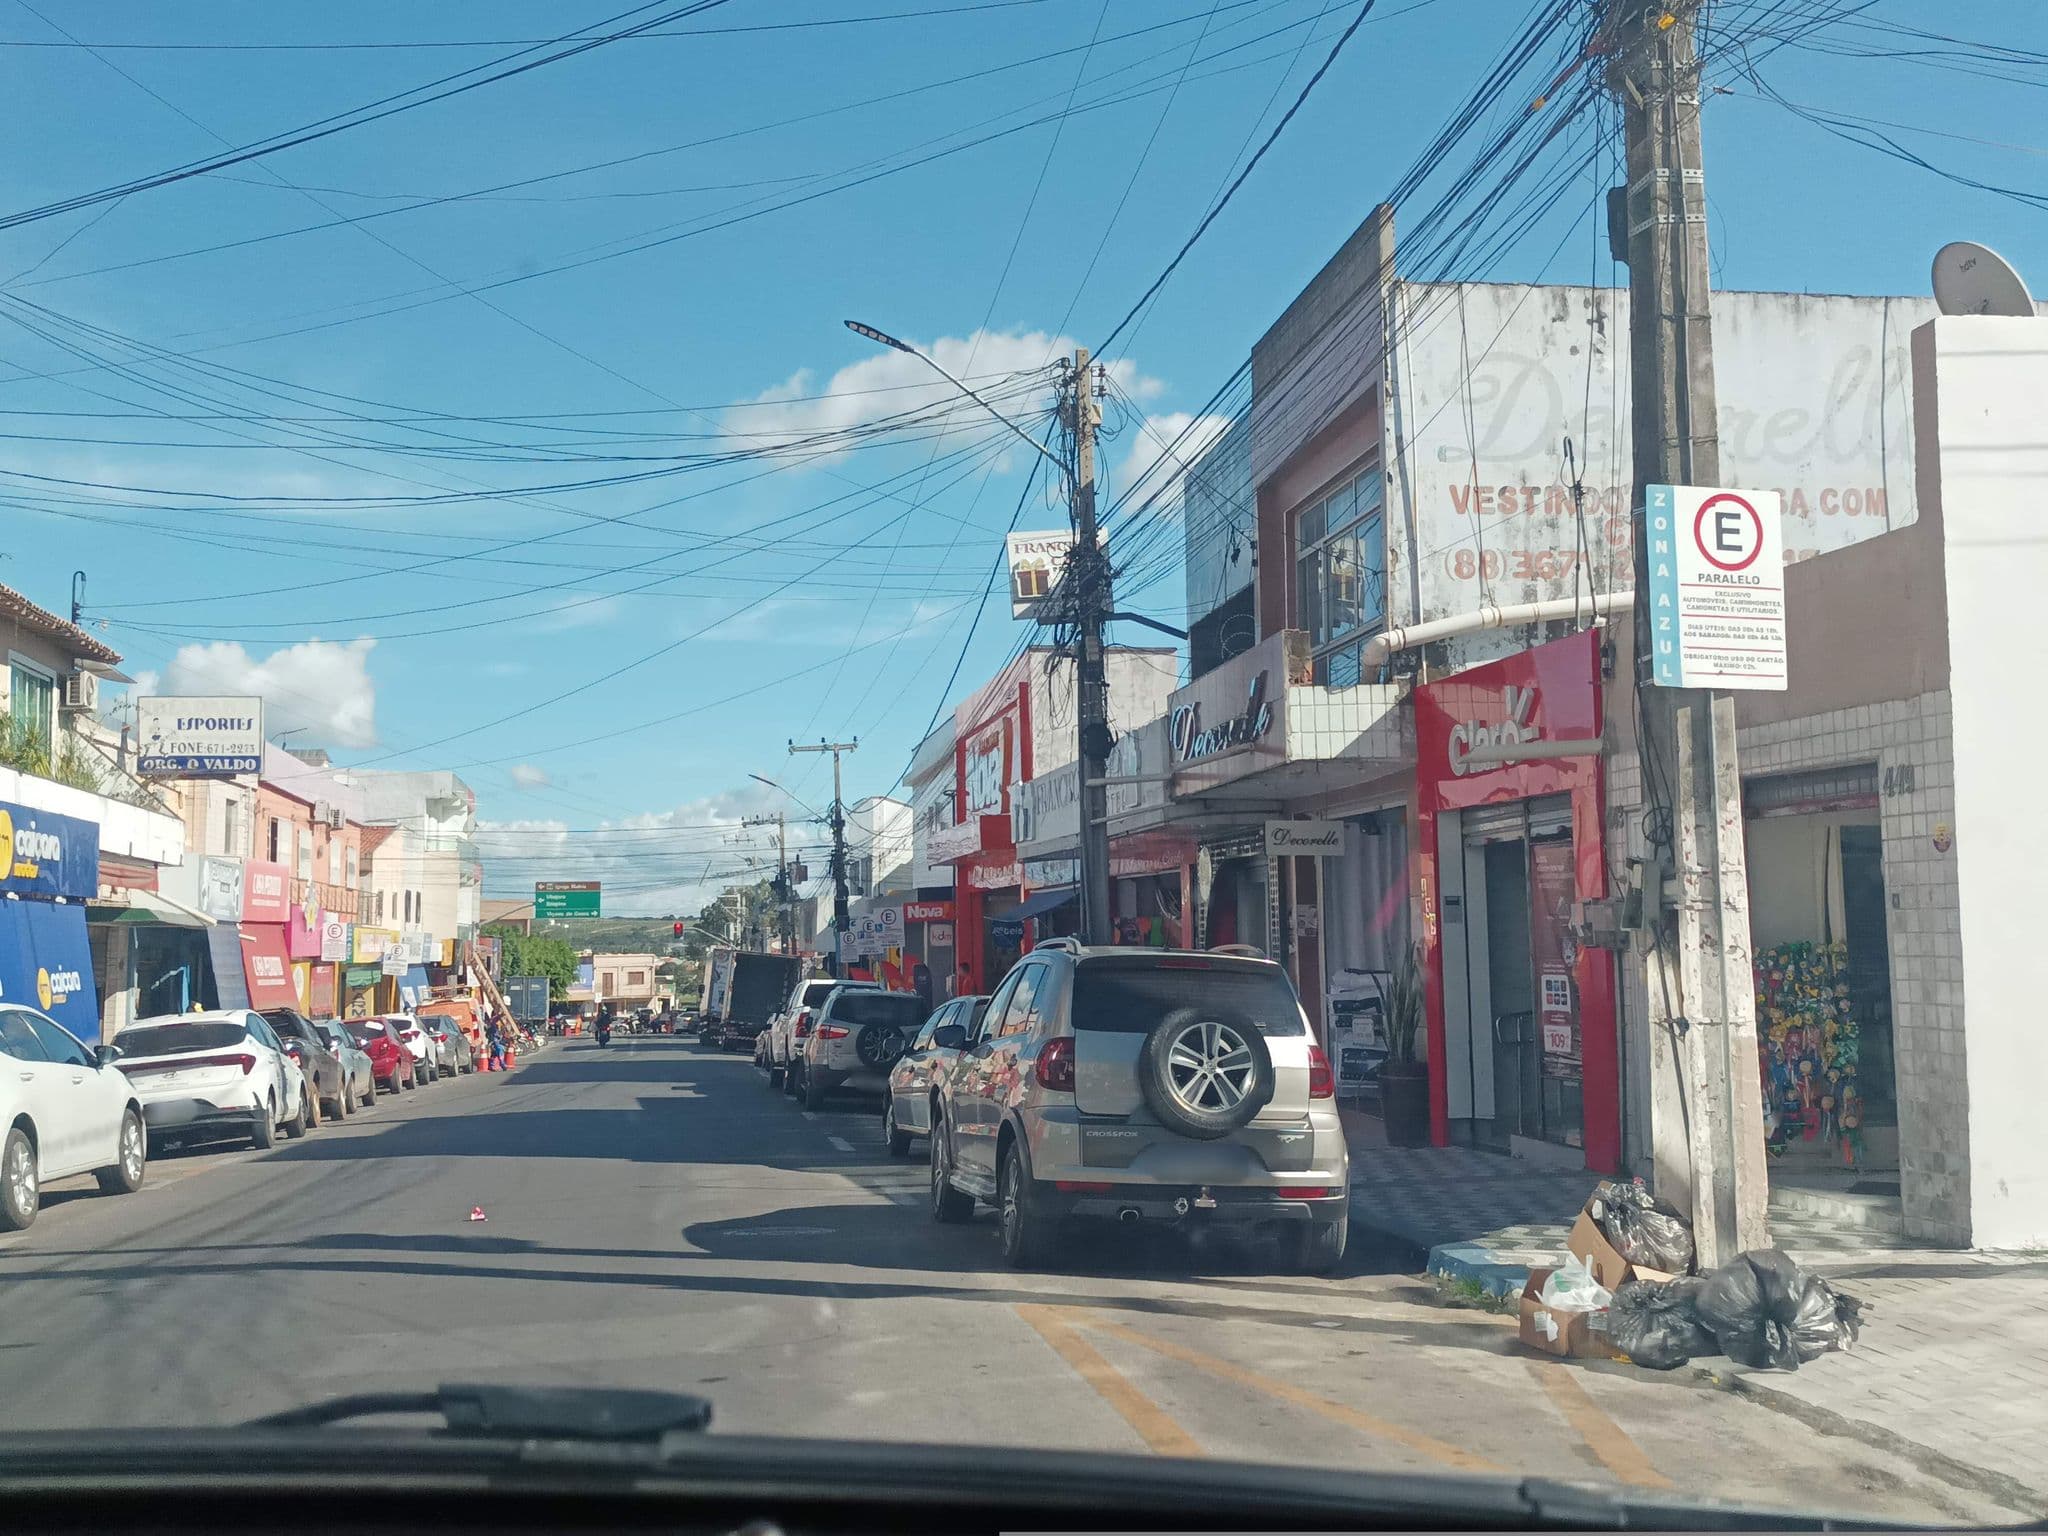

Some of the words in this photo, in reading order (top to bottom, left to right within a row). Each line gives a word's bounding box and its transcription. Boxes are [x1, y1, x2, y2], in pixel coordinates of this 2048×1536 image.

[1820, 488, 1886, 517] COM
[1654, 492, 1670, 577] ZONA
[1715, 511, 1743, 552] E
[1698, 572, 1760, 585] PARALELO
[1658, 593, 1673, 678] AZUL
[203, 758, 257, 770] VALDO
[1271, 828, 1339, 847] Decorelle
